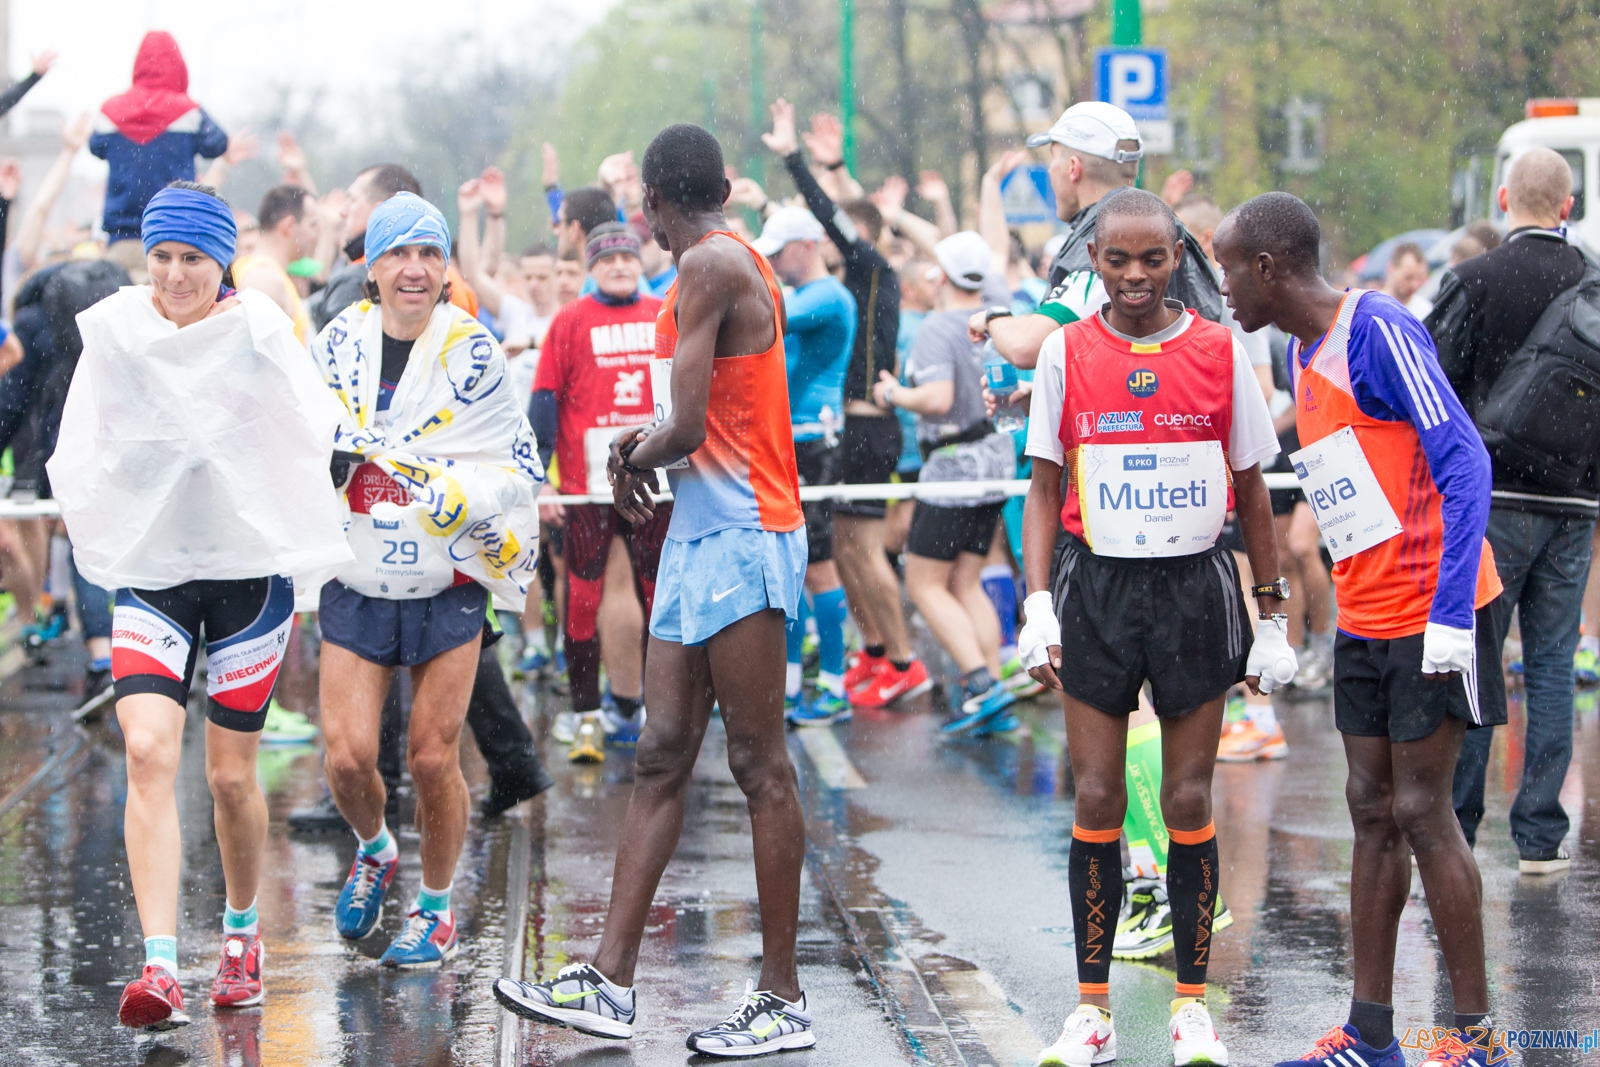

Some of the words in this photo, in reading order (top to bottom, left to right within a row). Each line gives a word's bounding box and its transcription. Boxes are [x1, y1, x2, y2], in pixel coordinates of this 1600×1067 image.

[1129, 372, 1156, 387] JP
[1098, 410, 1144, 425] AZUAY
[1097, 423, 1144, 433] PREFECTURA
[1136, 457, 1153, 467] PKO
[1099, 479, 1207, 511] Muteti
[1144, 514, 1173, 523] Daniel
[1166, 535, 1181, 544] 4F
[381, 539, 419, 565] 29
[375, 567, 425, 577] Przemysław
[223, 653, 240, 663] PORTAL
[241, 649, 252, 657] DLA
[252, 638, 275, 653] BIEGACZY
[224, 650, 279, 683] BIEGANIU
[1088, 857, 1101, 890] SPORT
[1200, 857, 1212, 891] SPORT
